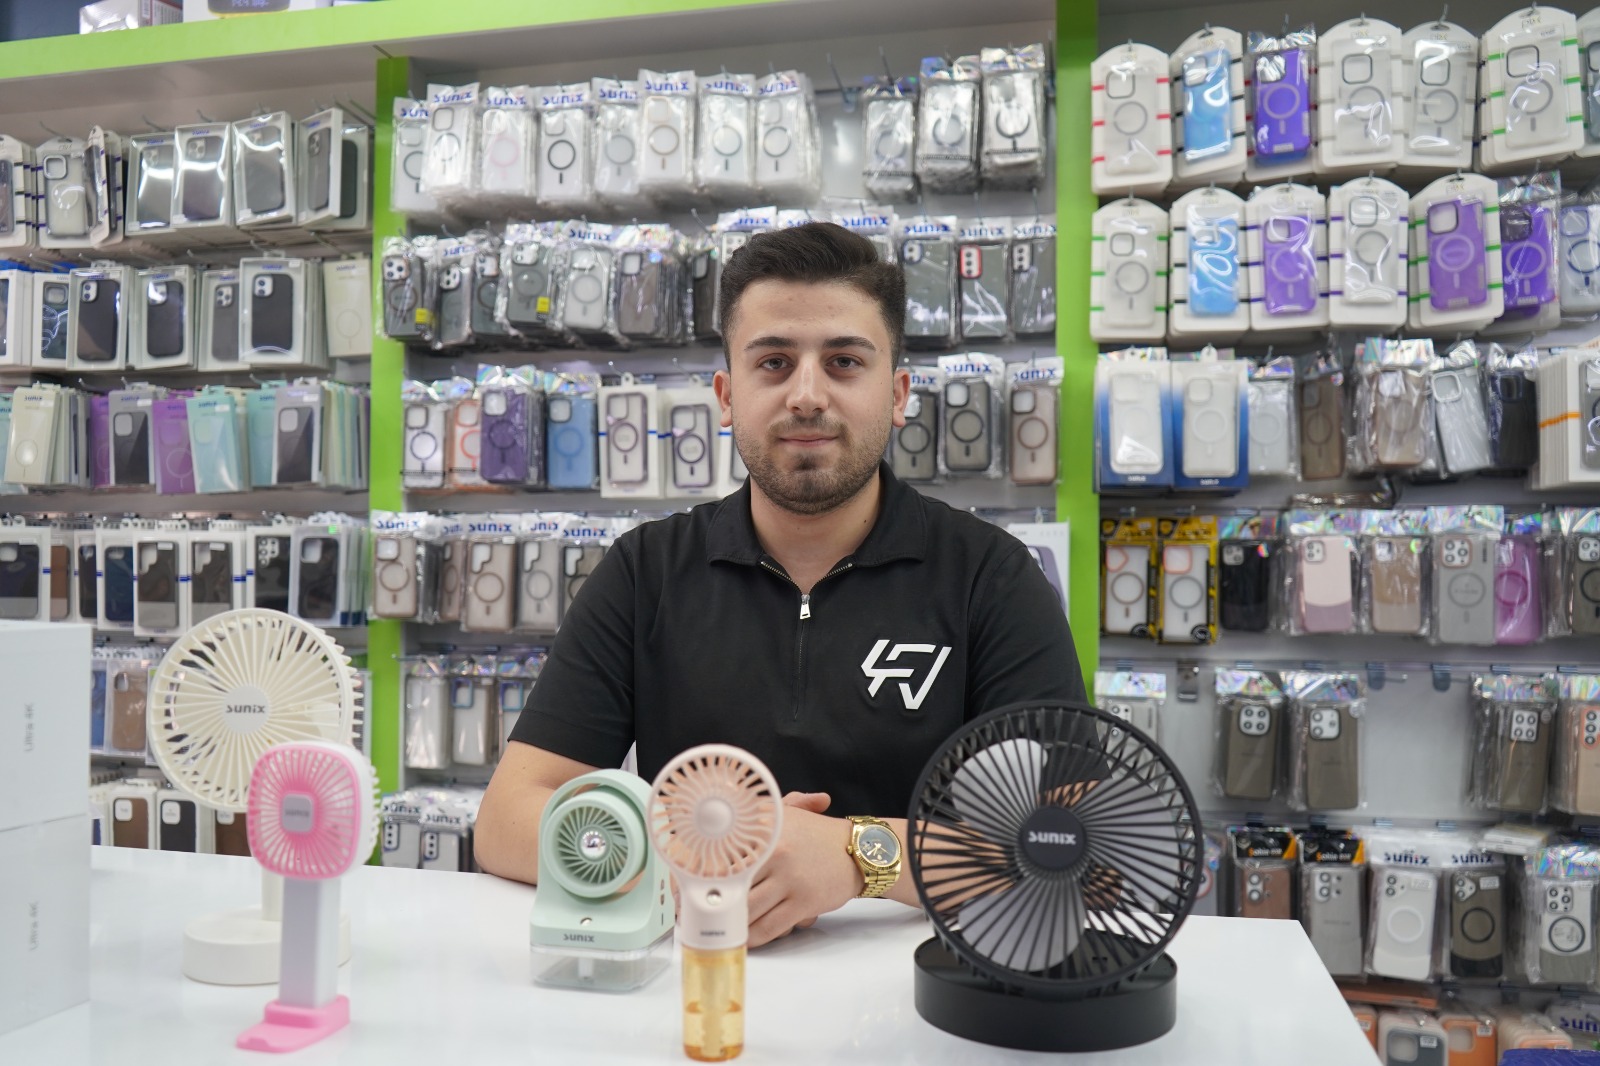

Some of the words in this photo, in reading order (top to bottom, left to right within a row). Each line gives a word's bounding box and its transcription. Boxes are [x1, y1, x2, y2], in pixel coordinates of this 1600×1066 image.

[645, 80, 689, 92] sunix
[434, 91, 473, 103] sunix
[543, 93, 583, 106] sunix
[401, 106, 429, 119] sun
[842, 215, 890, 228] sunix
[569, 228, 611, 242] sunix
[904, 224, 951, 234] sunix
[960, 227, 1004, 237] sunix
[946, 362, 993, 374] sunix
[911, 373, 936, 385] nix
[376, 519, 419, 530] sunix
[469, 522, 513, 534] sunix
[563, 528, 607, 539] sunix
[226, 702, 266, 715] sunix
[427, 814, 461, 825] sunix
[1028, 830, 1077, 846] sunix
[1384, 851, 1430, 866] sunix
[1452, 850, 1495, 865] sunix
[563, 933, 595, 943] sunix
[1561, 1016, 1600, 1033] sun
